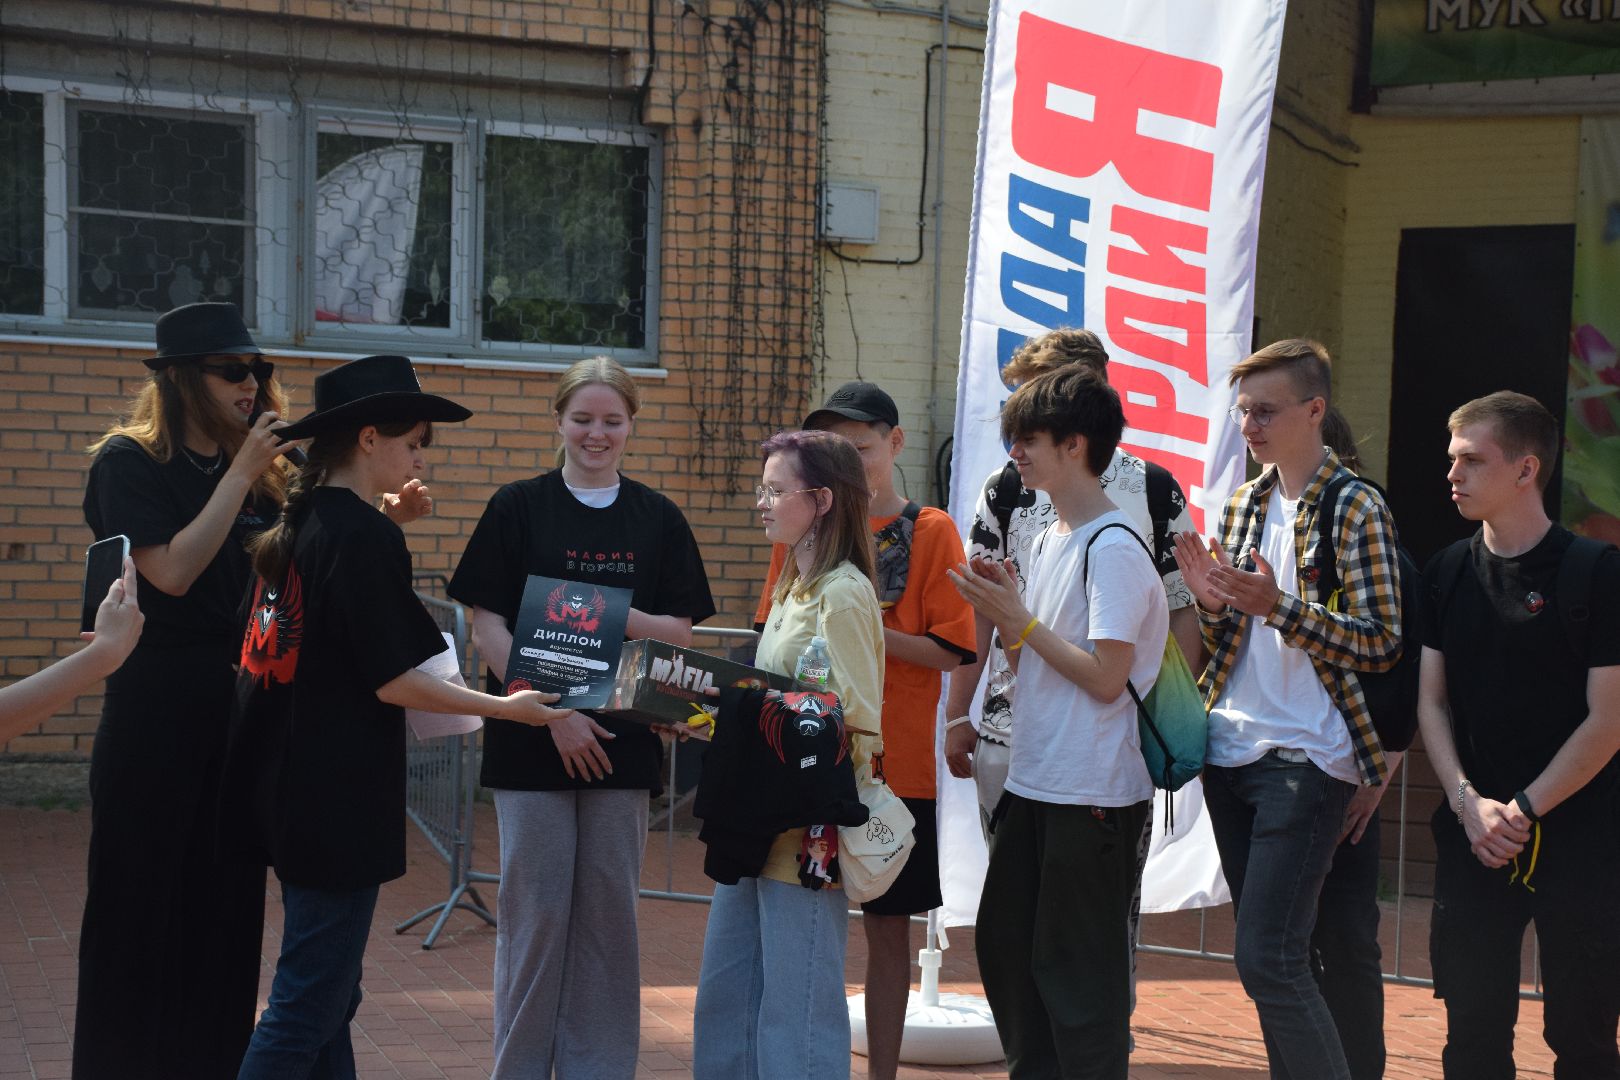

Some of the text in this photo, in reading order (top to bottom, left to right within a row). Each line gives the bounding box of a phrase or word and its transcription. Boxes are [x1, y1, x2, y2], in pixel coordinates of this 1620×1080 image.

[566, 549, 634, 561] МАФИЯ
[533, 628, 602, 649] ДИПЛОМ
[649, 649, 714, 694] MAFIA
